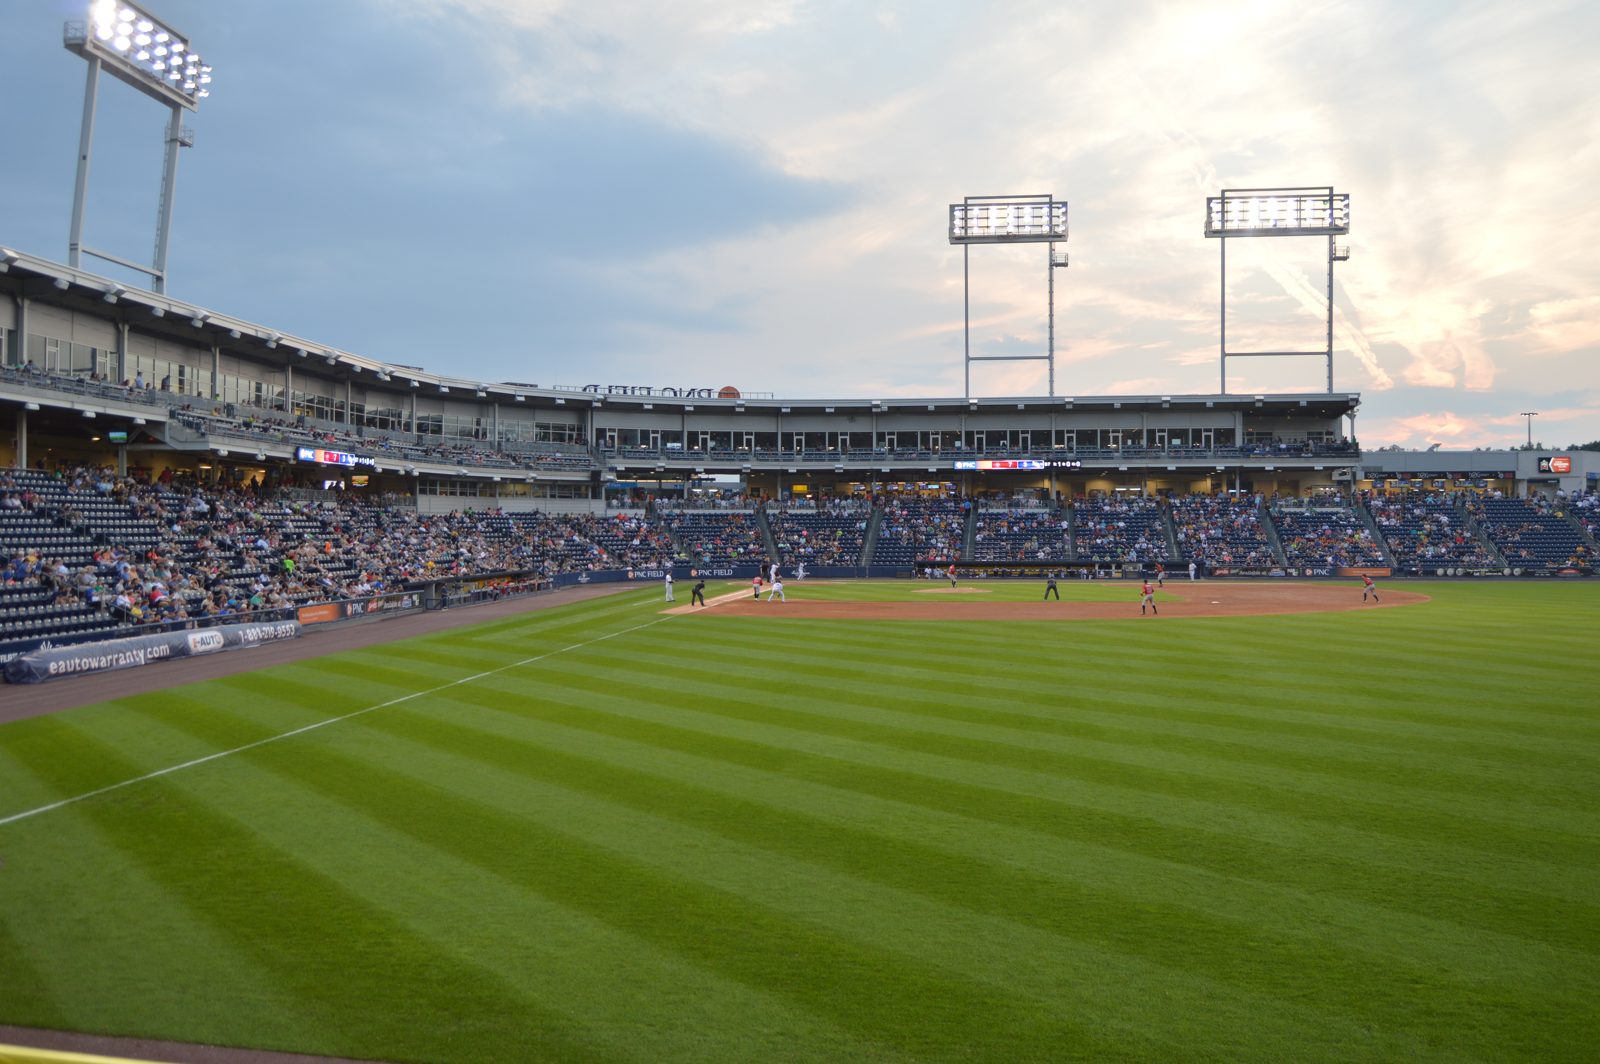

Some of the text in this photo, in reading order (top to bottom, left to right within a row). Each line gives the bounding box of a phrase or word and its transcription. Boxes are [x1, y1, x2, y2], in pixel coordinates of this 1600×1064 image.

[647, 570, 664, 578] FIELD
[713, 568, 733, 576] FIELD
[352, 602, 364, 615] PNC
[192, 632, 222, 649] E-AUTO
[49, 643, 170, 675] eautowarrantycom
